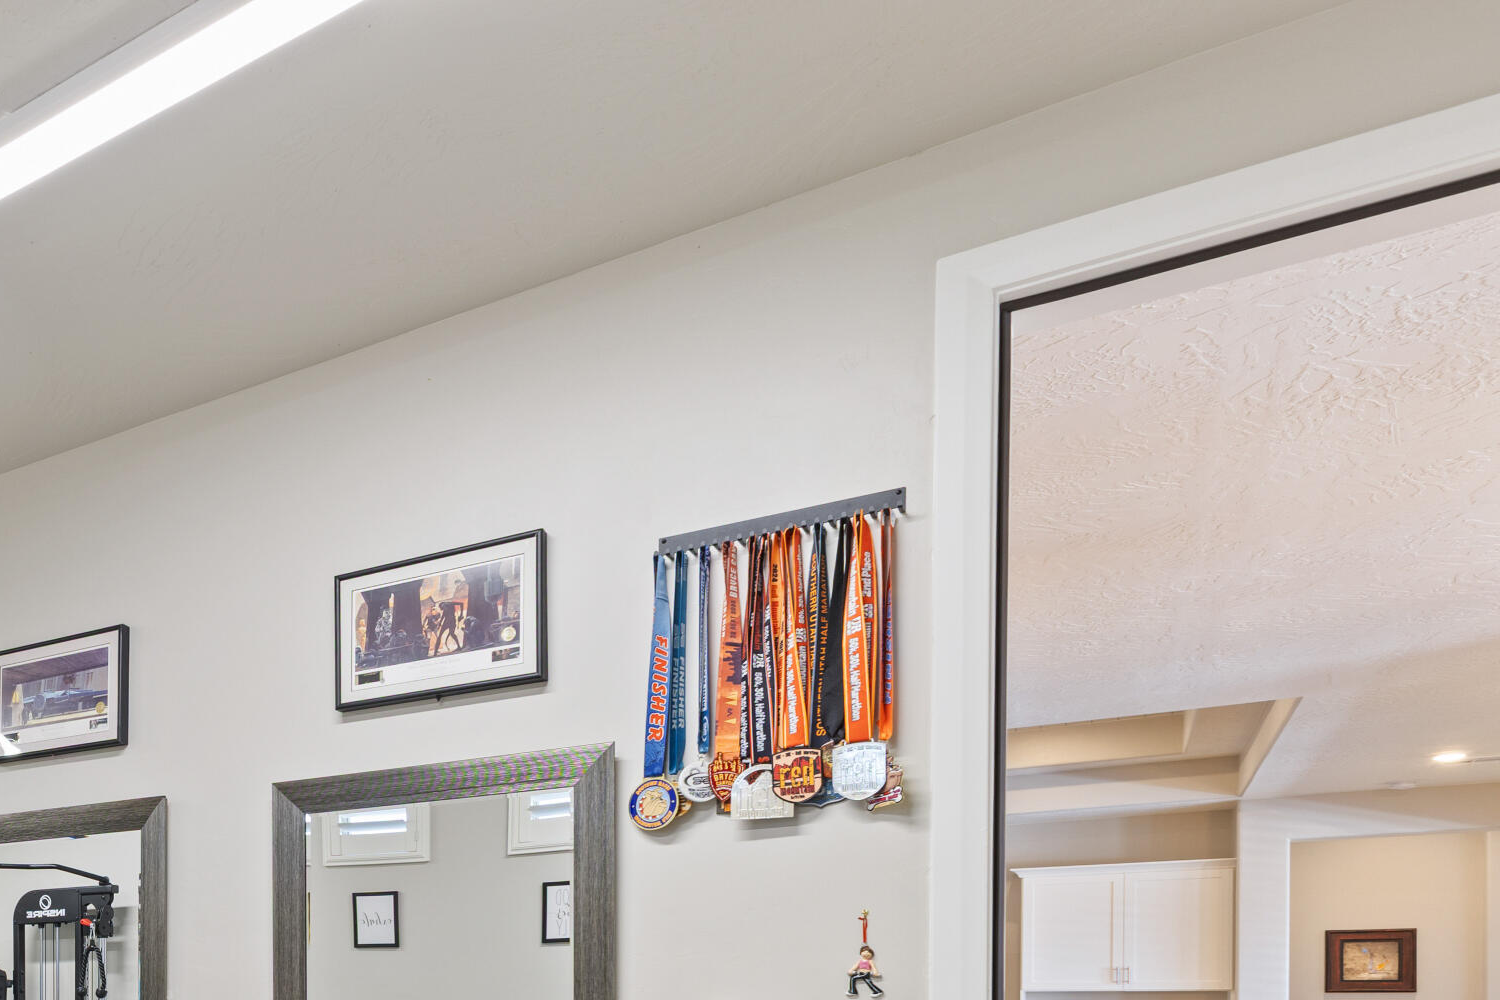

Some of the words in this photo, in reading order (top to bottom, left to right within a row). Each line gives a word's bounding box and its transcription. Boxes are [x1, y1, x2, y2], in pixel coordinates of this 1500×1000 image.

[809, 552, 818, 613] SOUTHERN
[647, 635, 669, 742] FINISHER
[671, 657, 679, 729] FINISHER
[779, 757, 814, 788] red
